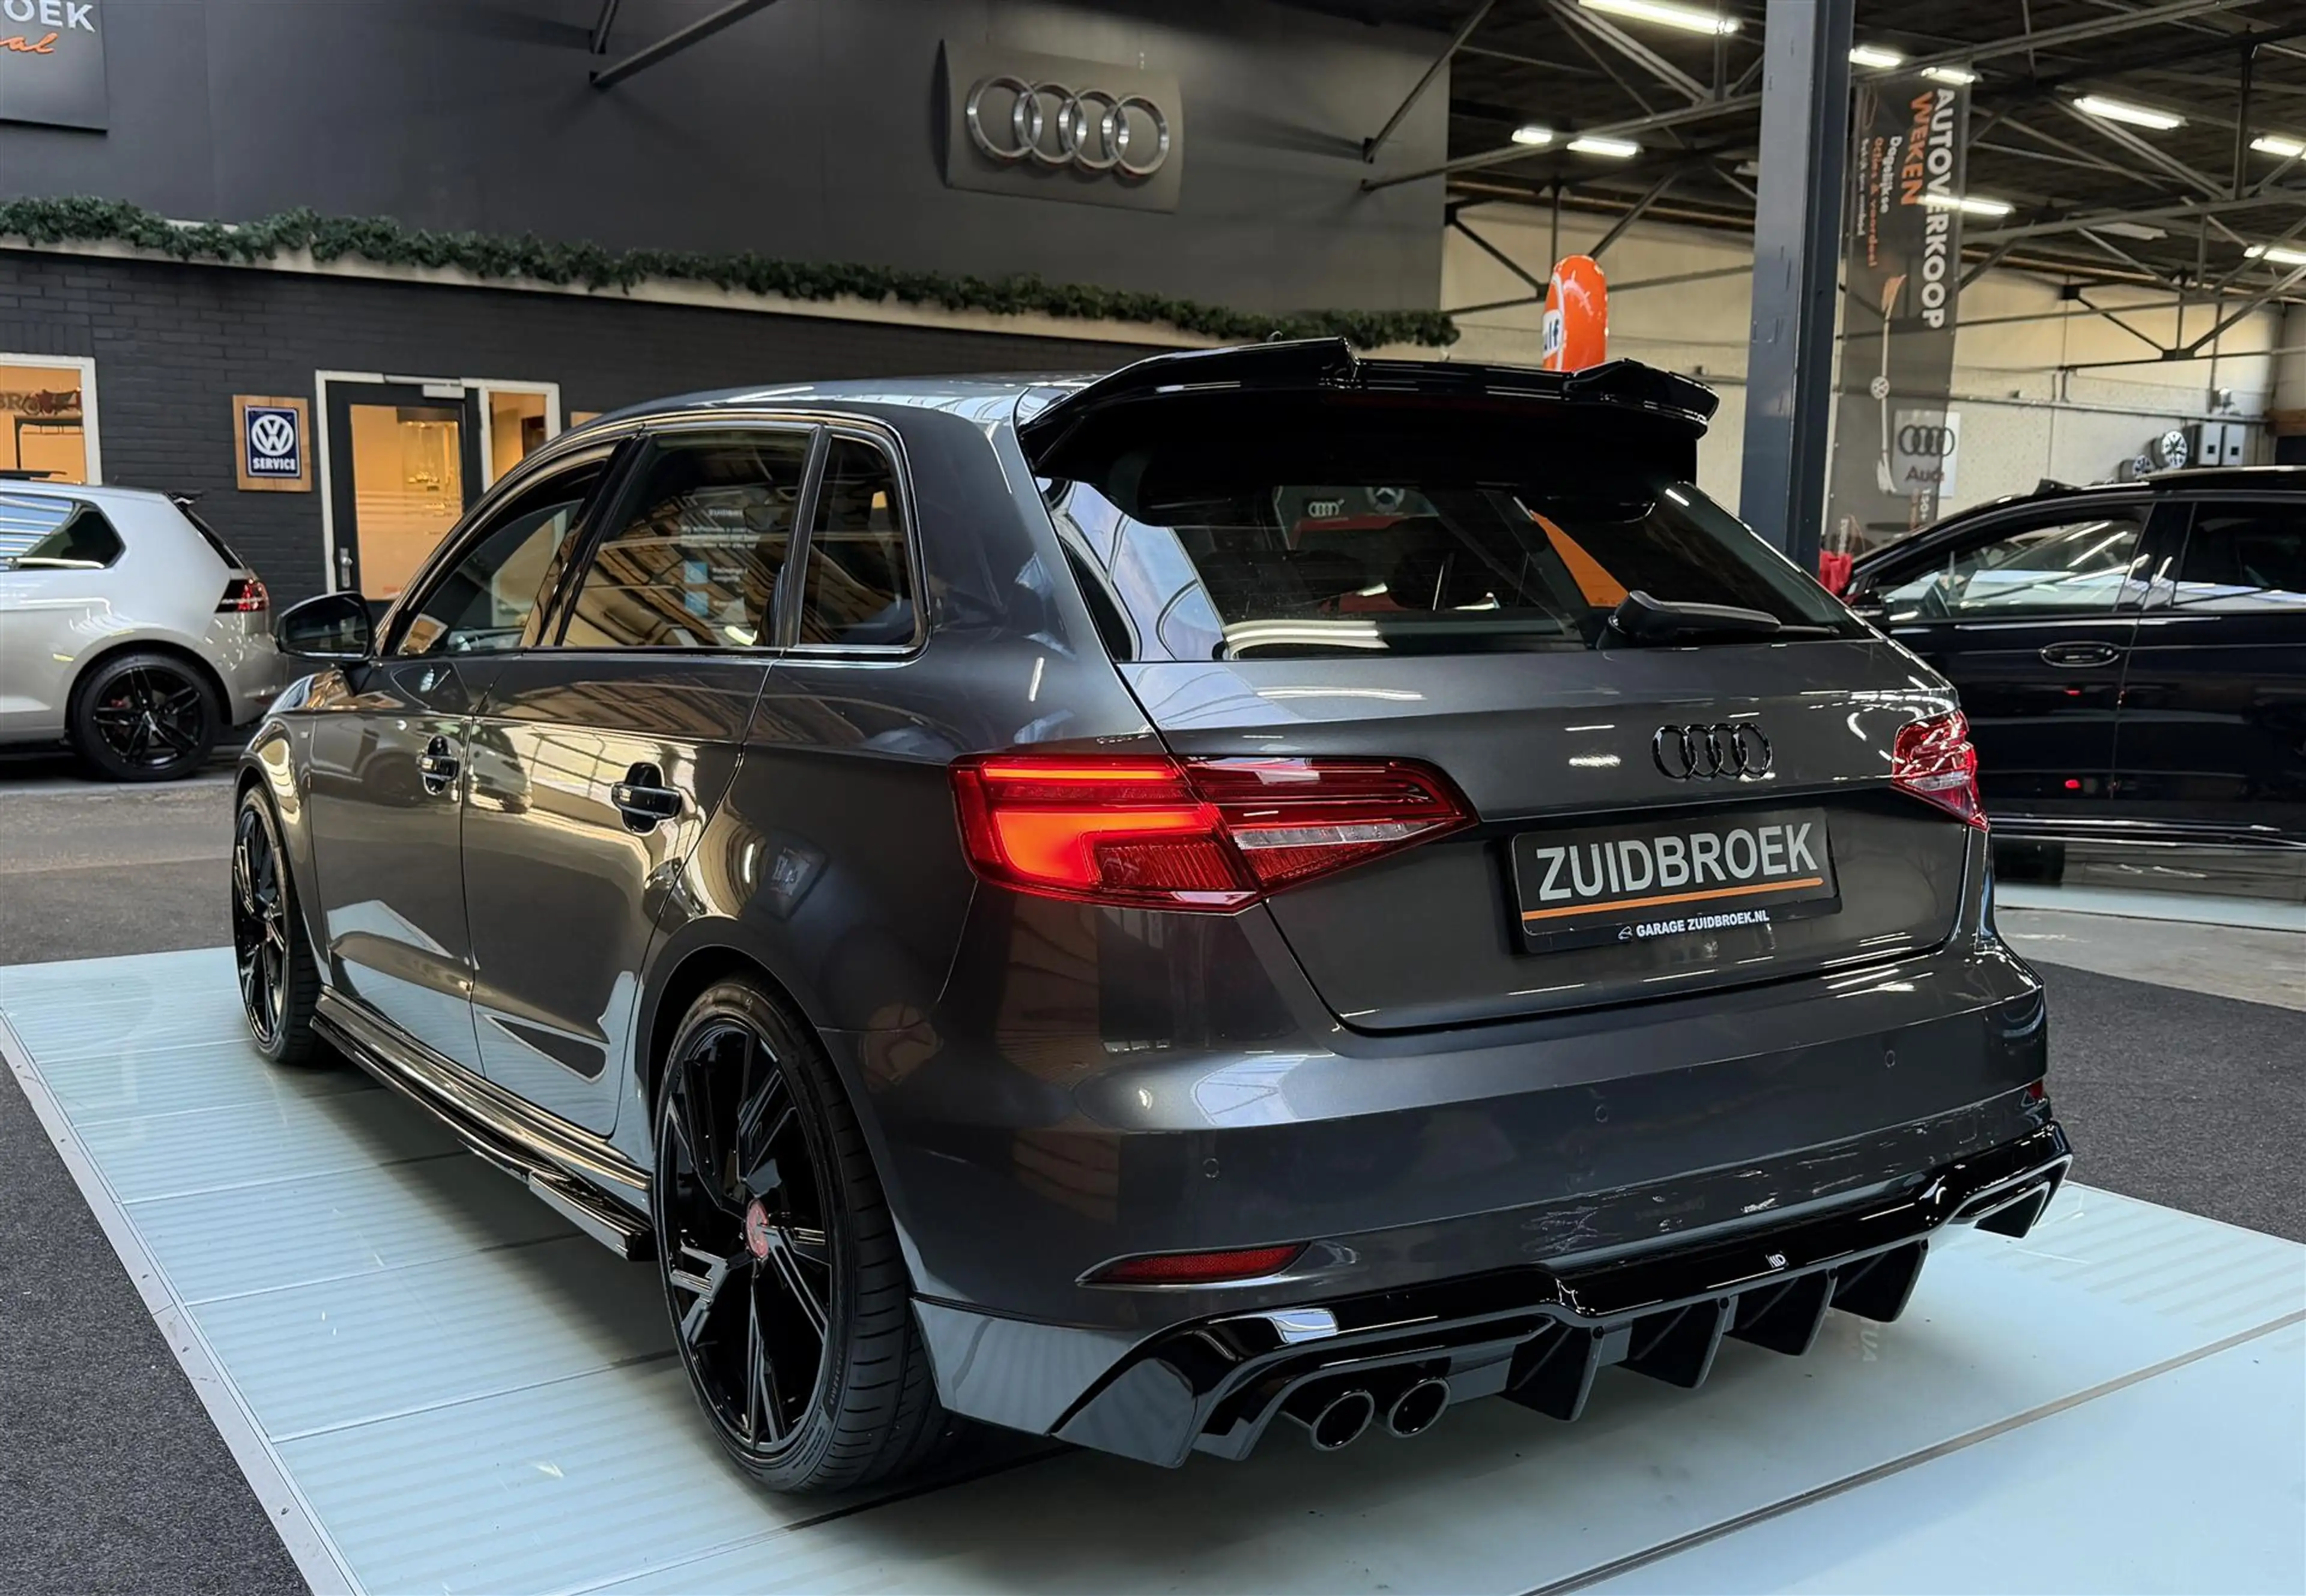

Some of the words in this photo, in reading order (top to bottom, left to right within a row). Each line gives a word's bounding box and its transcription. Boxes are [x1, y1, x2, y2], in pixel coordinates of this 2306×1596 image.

[4, 0, 95, 33] OEK
[1900, 91, 1934, 205] WEKEN
[1922, 88, 1955, 328] AUTOVERKOOP
[253, 458, 296, 470] SERVICE
[1904, 465, 1945, 482] Audi
[1536, 822, 1818, 901] ZUIDBROEK
[1636, 919, 1686, 937] GARAGE
[1687, 909, 1770, 931] ZUIDBROEK.NL
